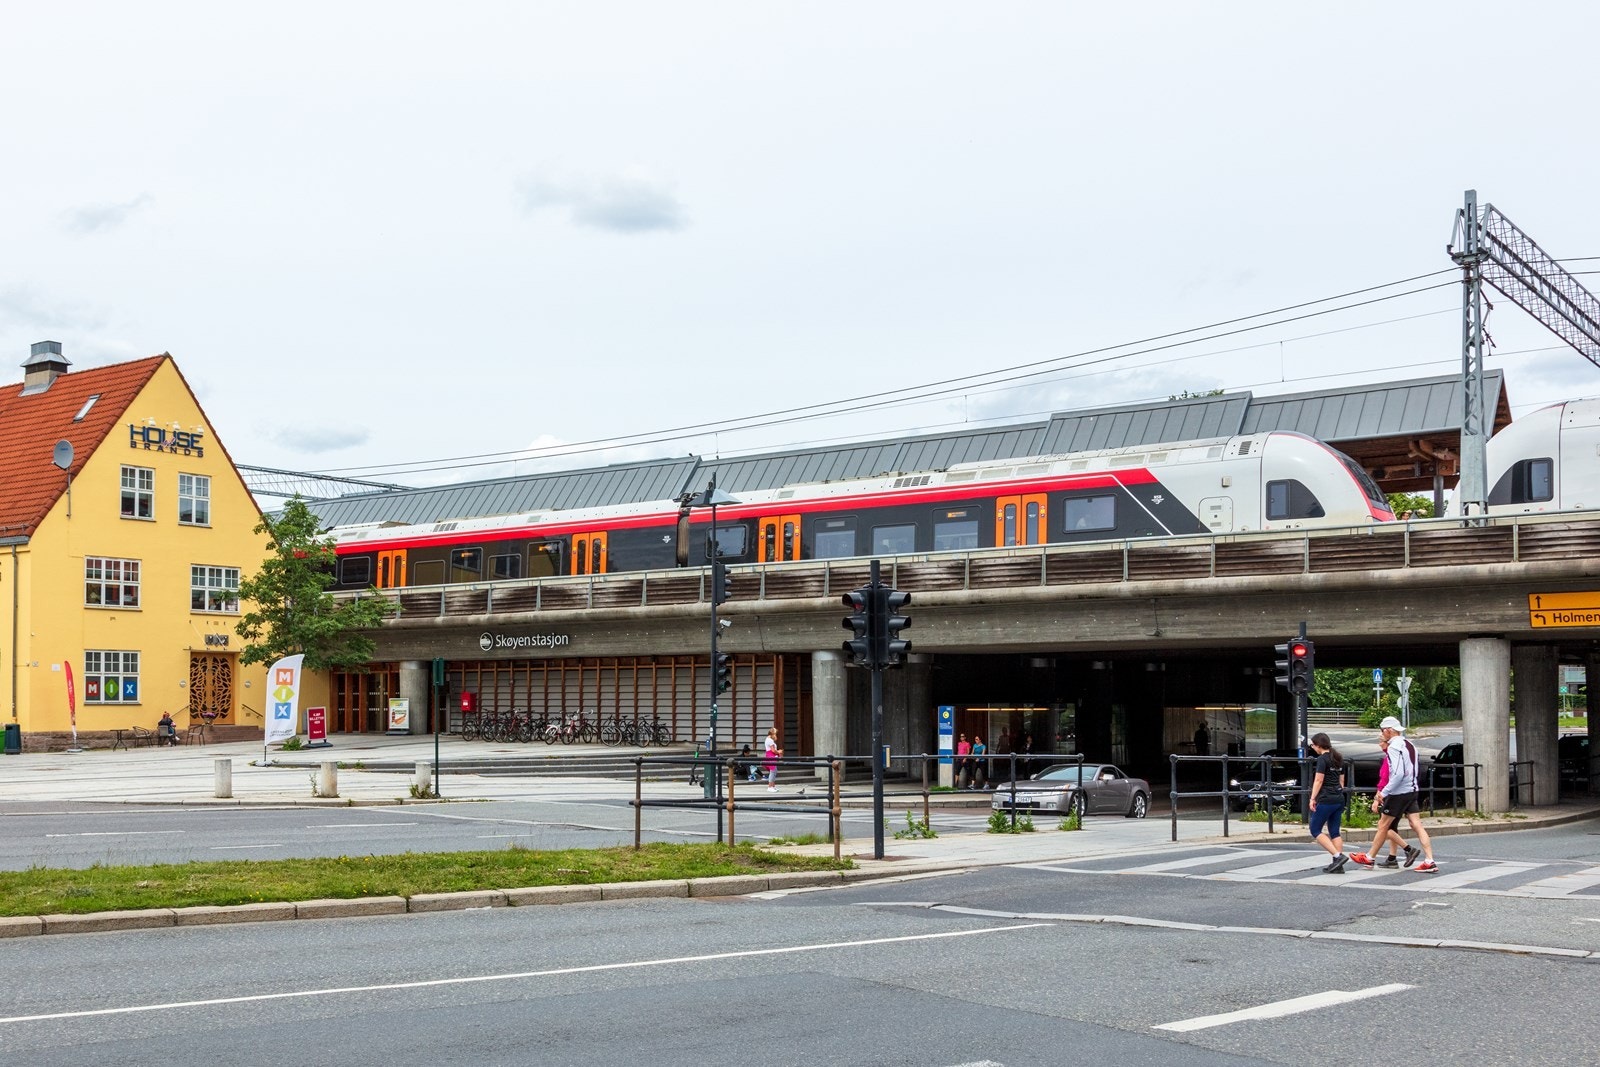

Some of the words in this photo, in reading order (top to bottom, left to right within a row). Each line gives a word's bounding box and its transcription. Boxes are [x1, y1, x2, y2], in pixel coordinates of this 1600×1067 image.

[130, 424, 204, 450] HOUSE
[130, 440, 204, 458] BRANDS
[495, 634, 531, 650] Skøyen
[531, 632, 569, 649] stasjon
[88, 683, 134, 694] MIX
[278, 671, 290, 717] MIX
